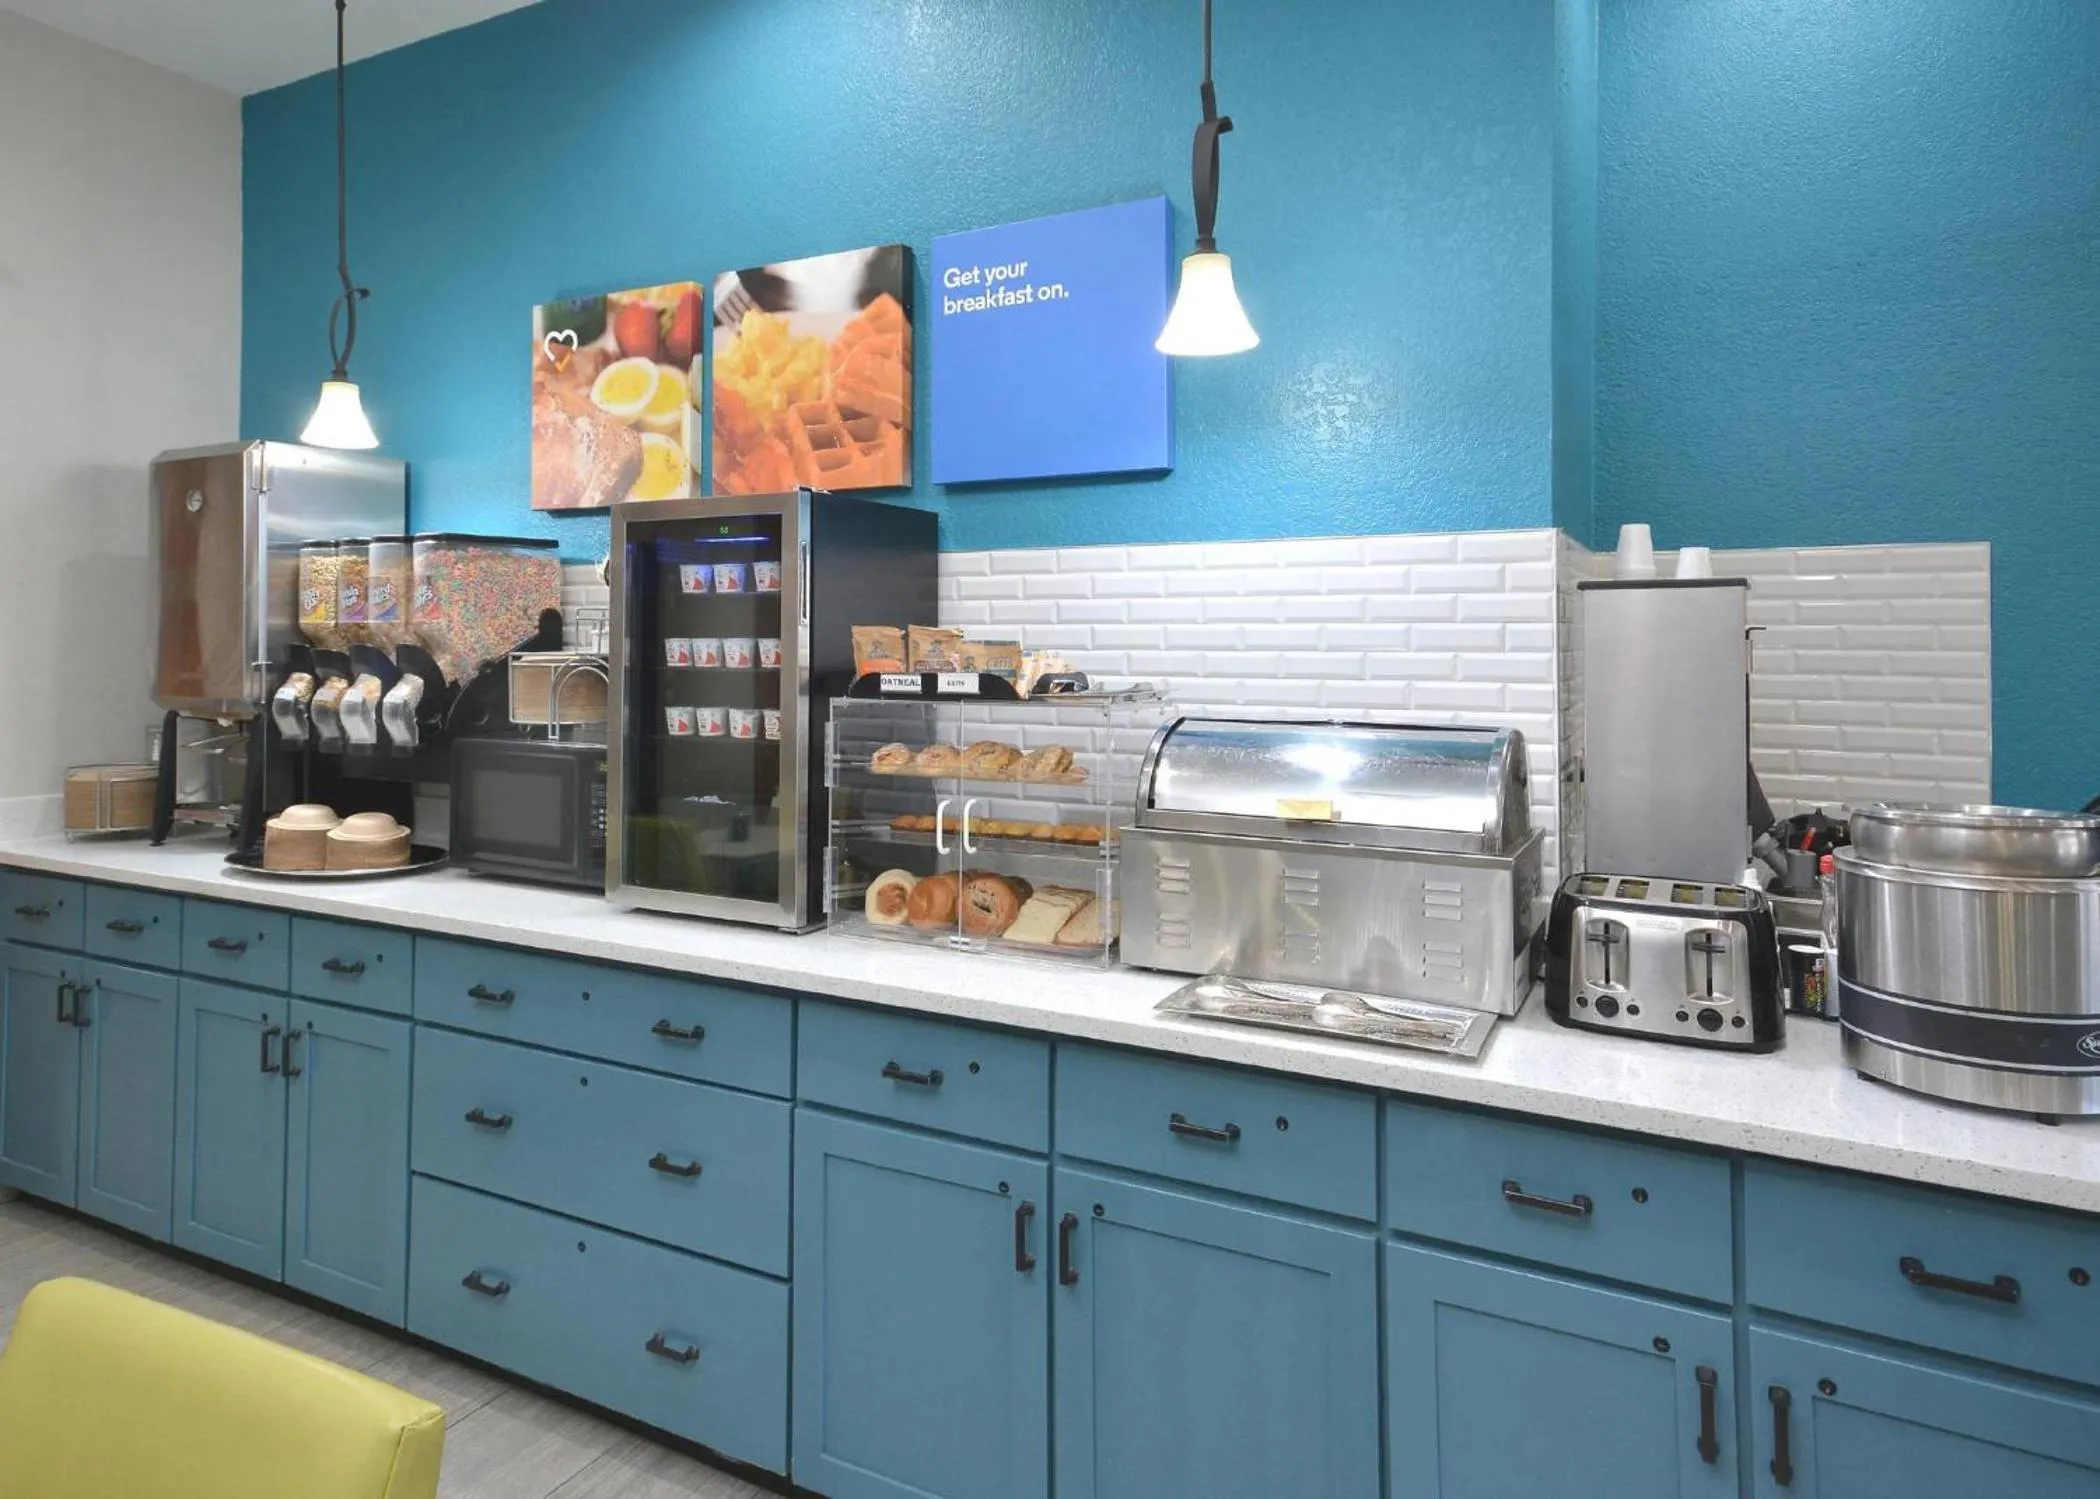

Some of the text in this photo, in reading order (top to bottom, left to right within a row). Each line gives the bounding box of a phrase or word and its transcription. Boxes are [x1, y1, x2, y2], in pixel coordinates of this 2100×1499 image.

[943, 260, 1029, 289] Get your
[943, 283, 1070, 316] breakfast on.
